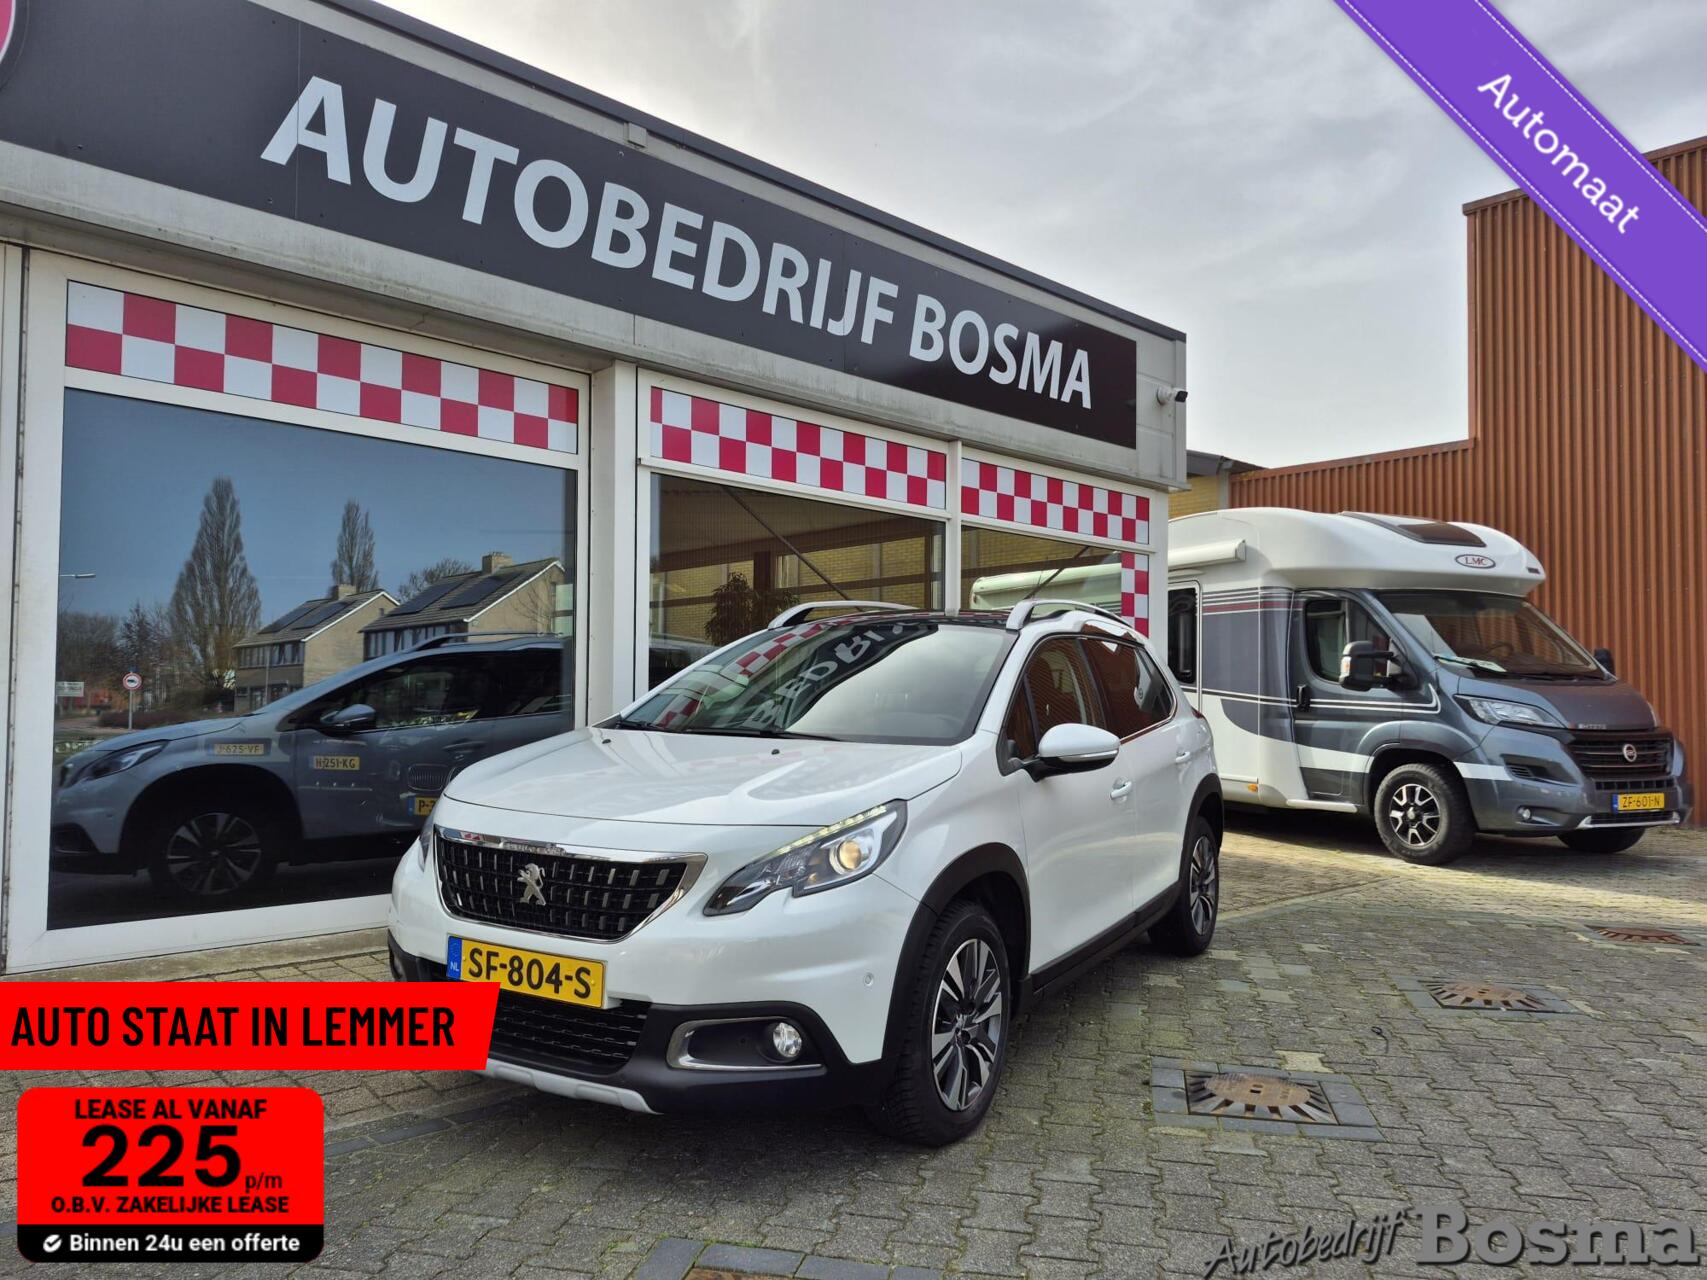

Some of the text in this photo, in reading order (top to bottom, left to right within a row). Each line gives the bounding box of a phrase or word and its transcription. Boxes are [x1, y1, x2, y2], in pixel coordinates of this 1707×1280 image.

[260, 75, 1092, 409] AUTOBEDRIJF BOSMA
[468, 947, 592, 999] SF-804-S
